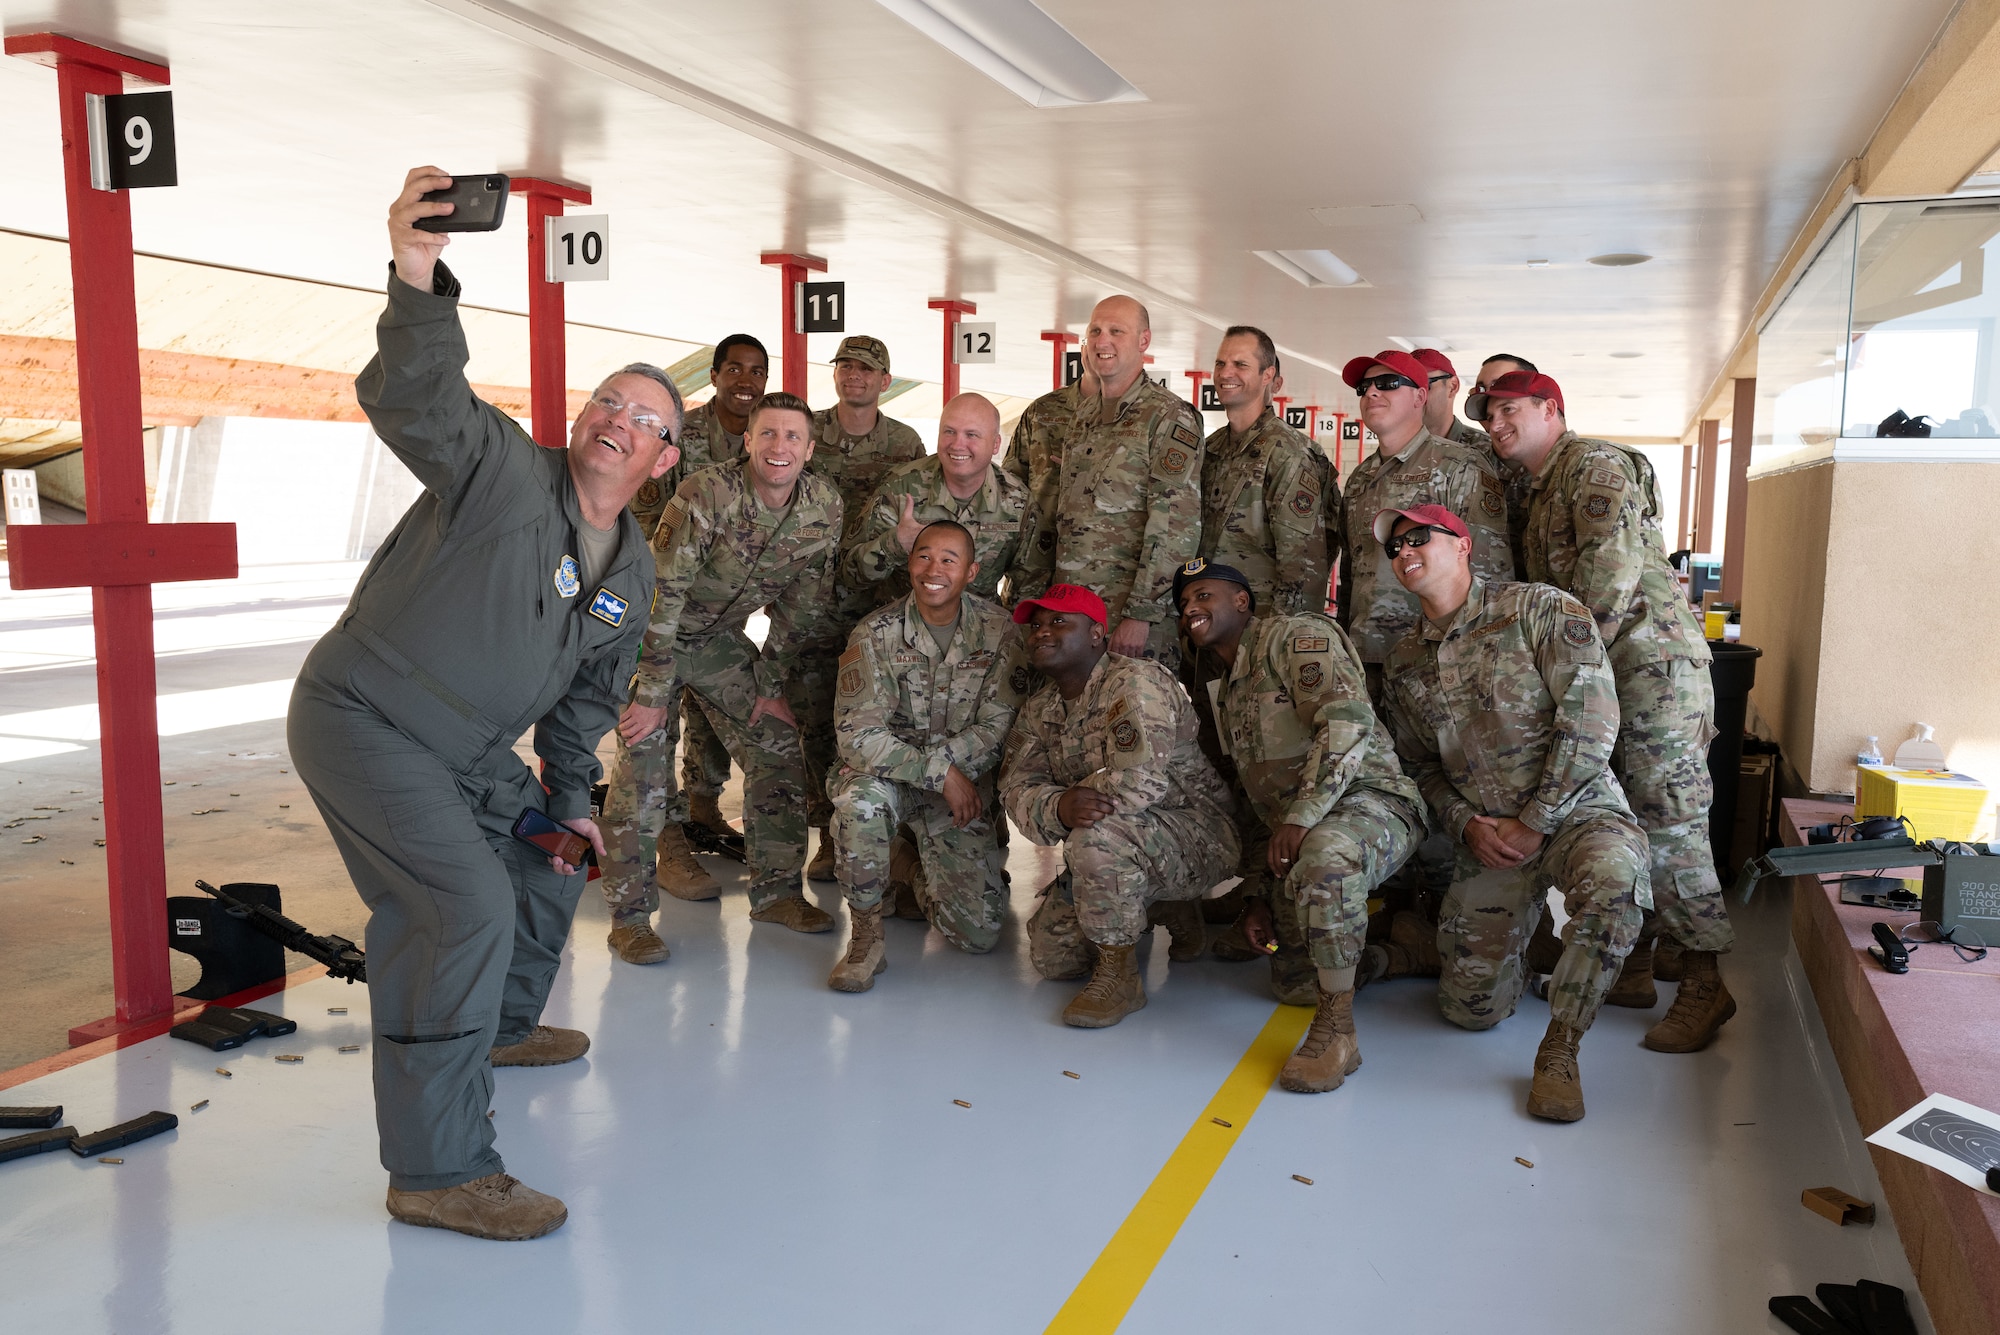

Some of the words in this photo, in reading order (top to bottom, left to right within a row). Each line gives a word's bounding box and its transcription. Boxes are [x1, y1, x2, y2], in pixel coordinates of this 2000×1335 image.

[125, 115, 153, 165] 9
[561, 231, 602, 265] 10
[808, 294, 838, 320] 11
[963, 332, 991, 353] 12
[1069, 360, 1078, 378] 1
[1288, 412, 1304, 424] 17
[1319, 421, 1334, 431] 18
[1344, 426, 1359, 436] 19
[1176, 429, 1196, 443] SF
[1595, 471, 1620, 485] SF
[1565, 601, 1589, 615] SF
[1298, 639, 1326, 650] SF
[1108, 700, 1123, 721] SF
[1961, 881, 1985, 890] 900
[1990, 883, 2000, 891] C
[1960, 898, 1973, 906] 10
[1963, 906, 1987, 915] LOT
